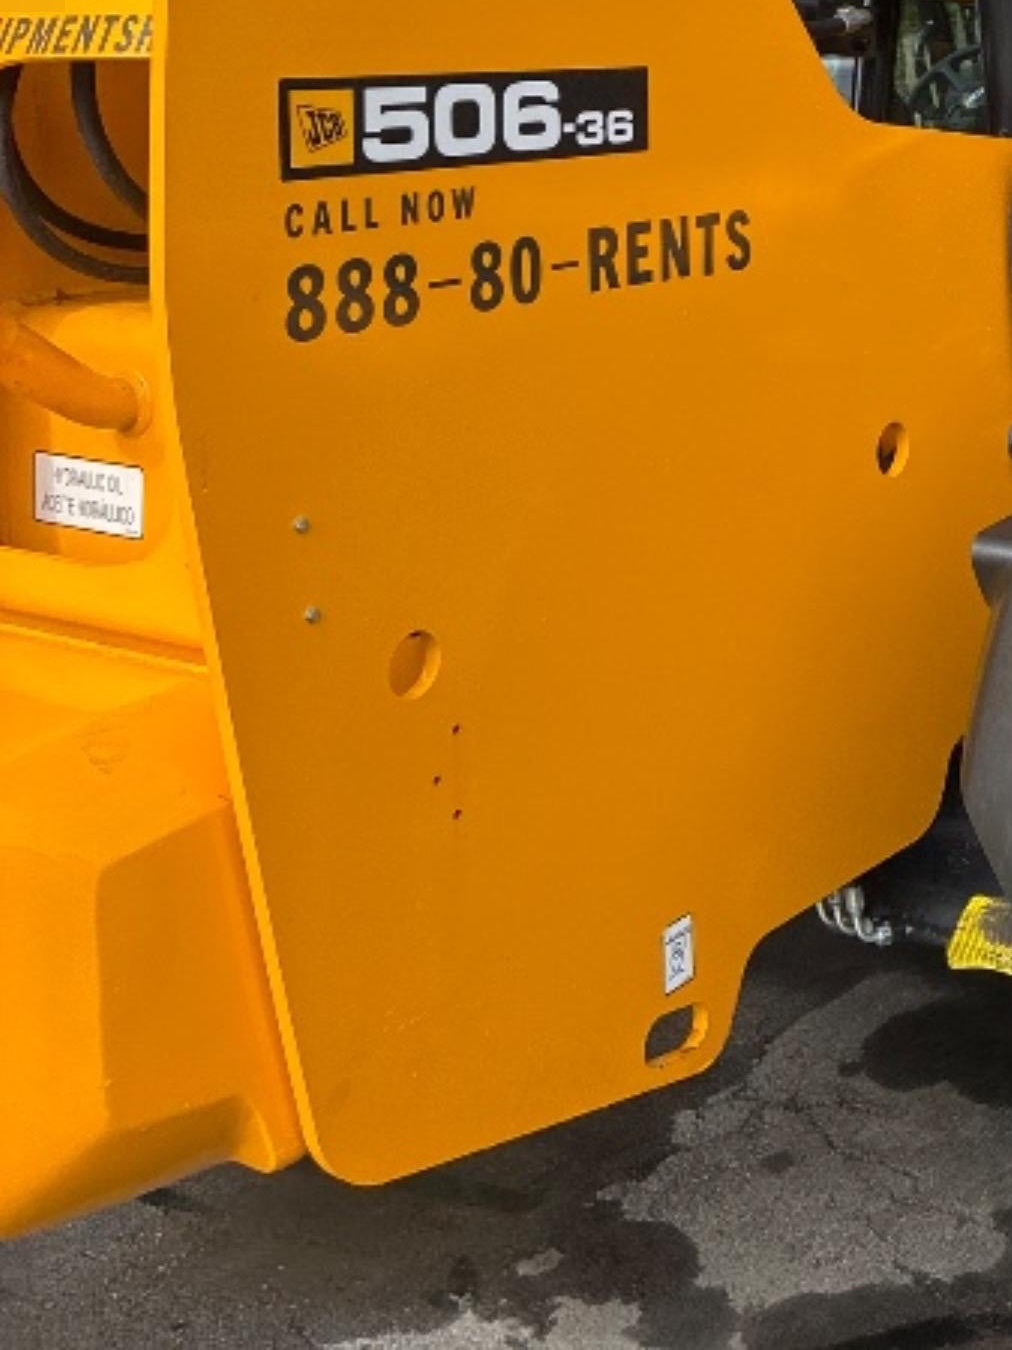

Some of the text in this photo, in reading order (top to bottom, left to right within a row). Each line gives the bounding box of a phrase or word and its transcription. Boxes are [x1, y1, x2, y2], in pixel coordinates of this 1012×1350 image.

[0, 14, 152, 55] IPMENTSH
[362, 79, 635, 164] 506-36
[284, 186, 476, 238] CALL NOW
[285, 210, 752, 343] 888-80-RENTS
